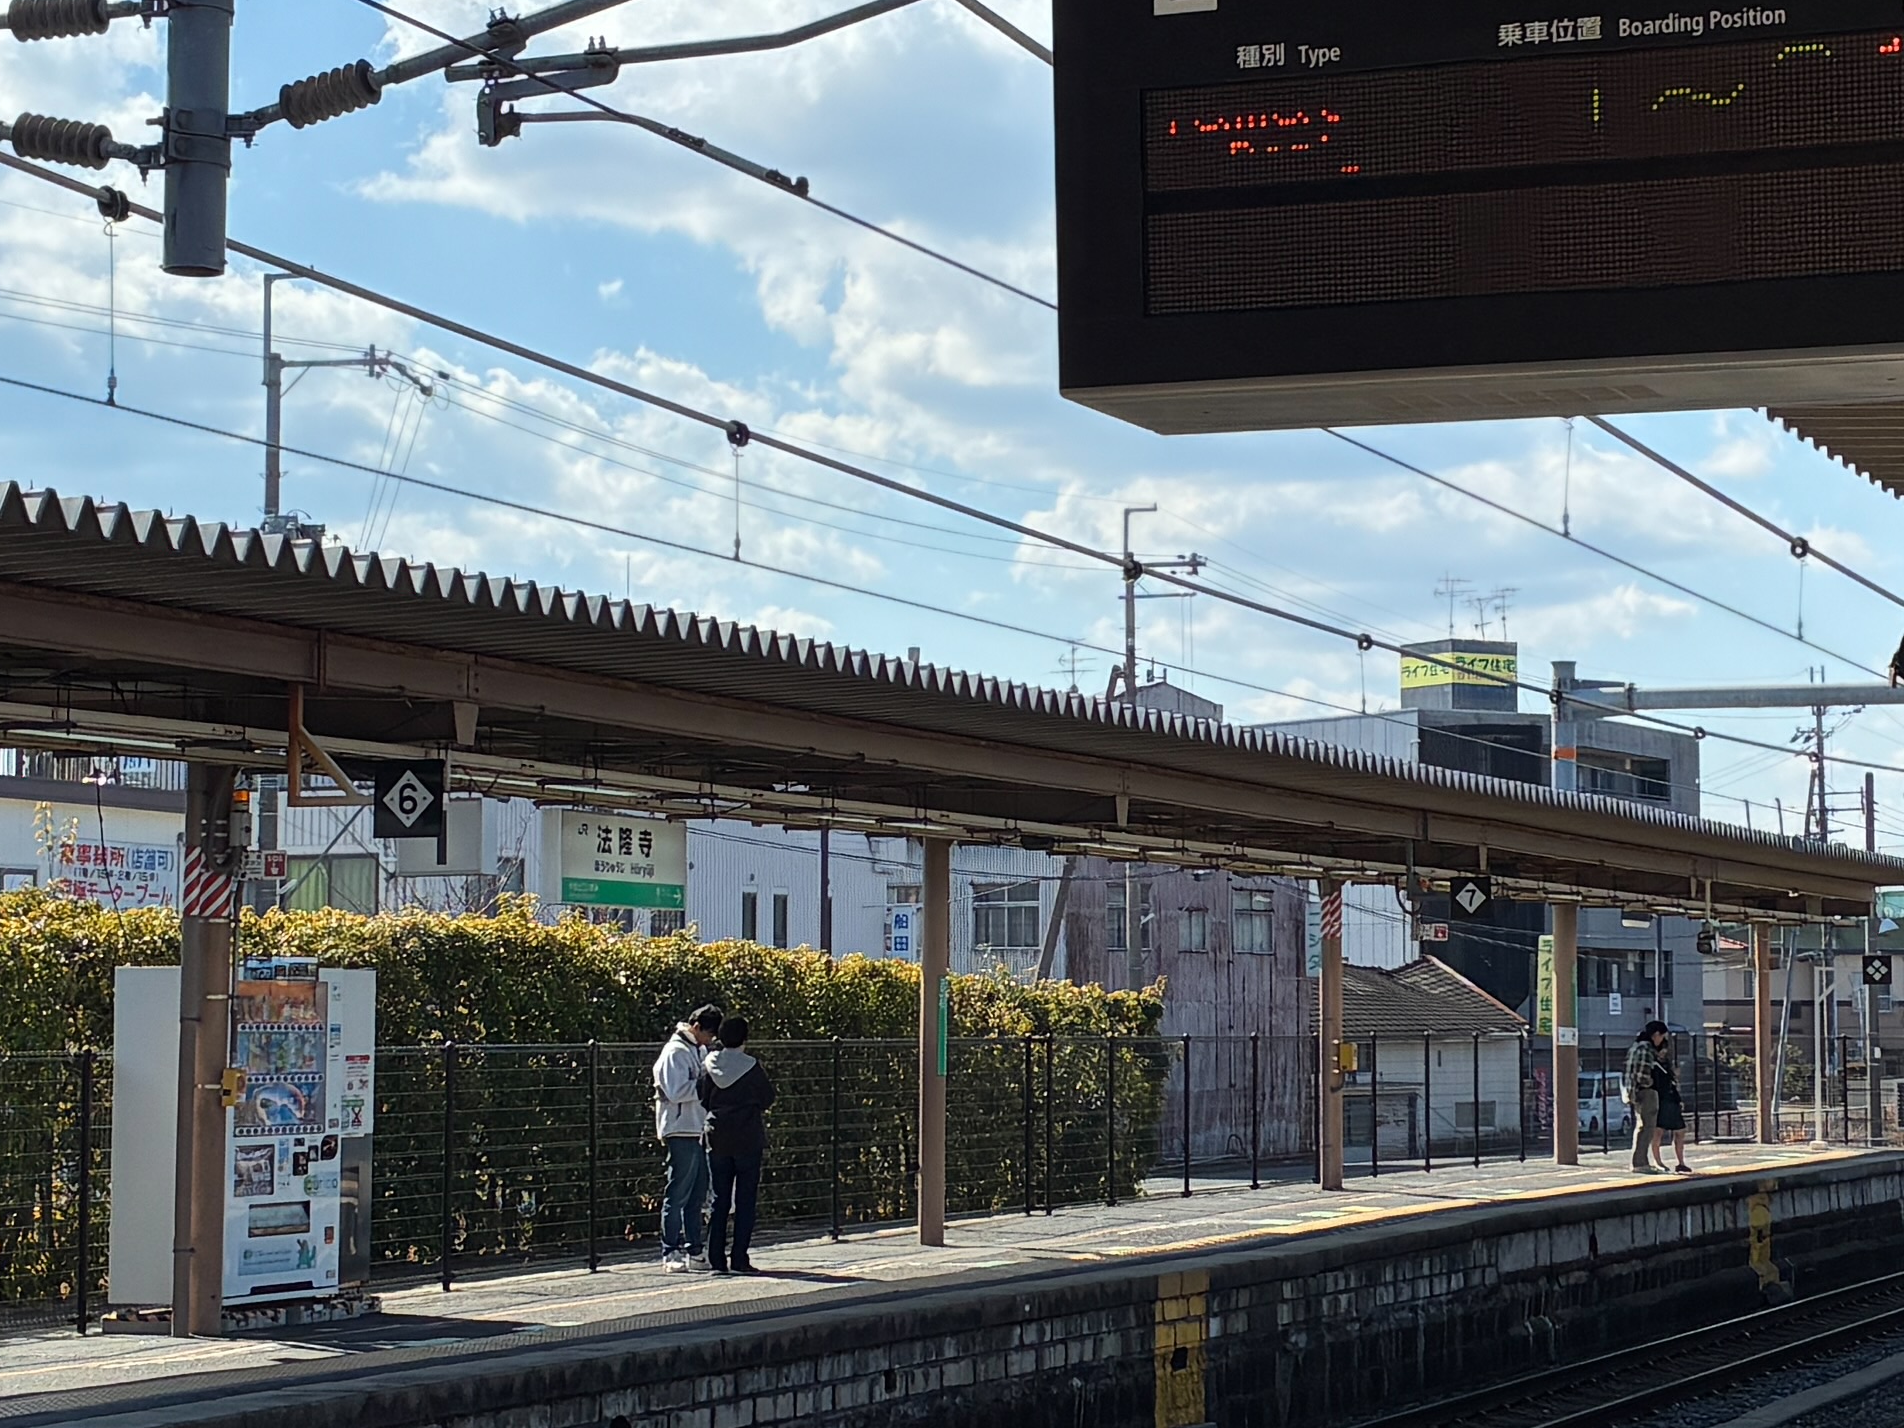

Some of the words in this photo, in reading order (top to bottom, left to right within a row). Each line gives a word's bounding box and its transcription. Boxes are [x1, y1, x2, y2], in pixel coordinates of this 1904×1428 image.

[1497, 16, 1602, 47] 乗車位置
[1618, 13, 1704, 38] Boarding
[1709, 7, 1786, 31] Position
[1236, 42, 1285, 69] 種別
[1298, 45, 1341, 68] Type
[399, 783, 417, 814] 6
[596, 825, 653, 858] 法隆寺
[1465, 889, 1476, 907] 7
